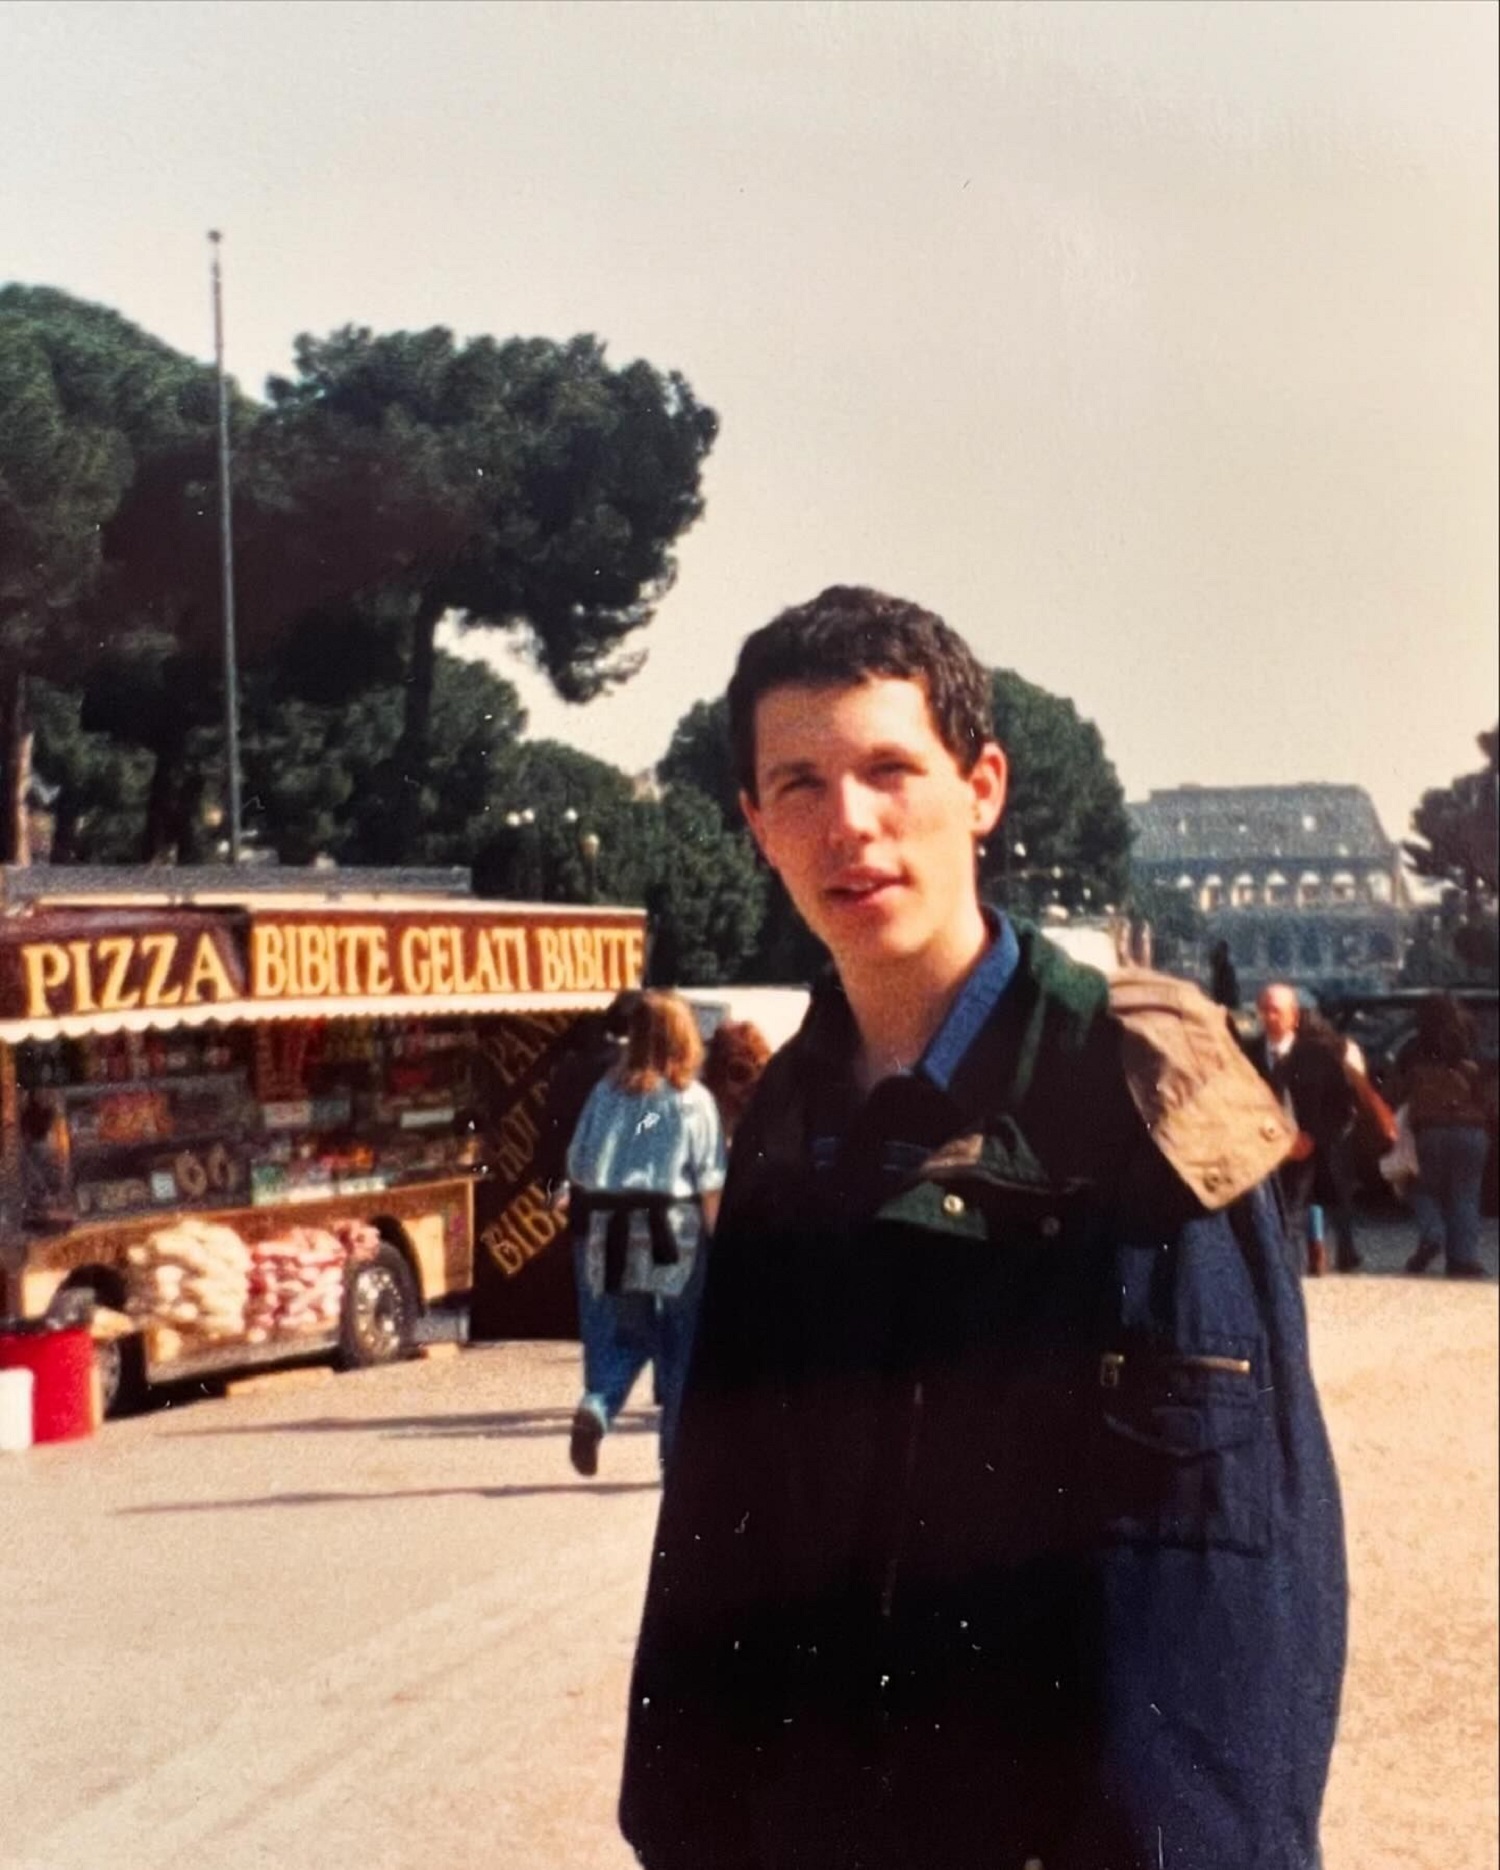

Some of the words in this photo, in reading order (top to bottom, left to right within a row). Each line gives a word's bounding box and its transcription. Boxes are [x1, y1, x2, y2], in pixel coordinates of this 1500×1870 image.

[21, 932, 238, 1018] PIZZA
[254, 925, 394, 997] BIBITE
[401, 926, 532, 995] GELATI
[537, 927, 644, 992] BIBITE
